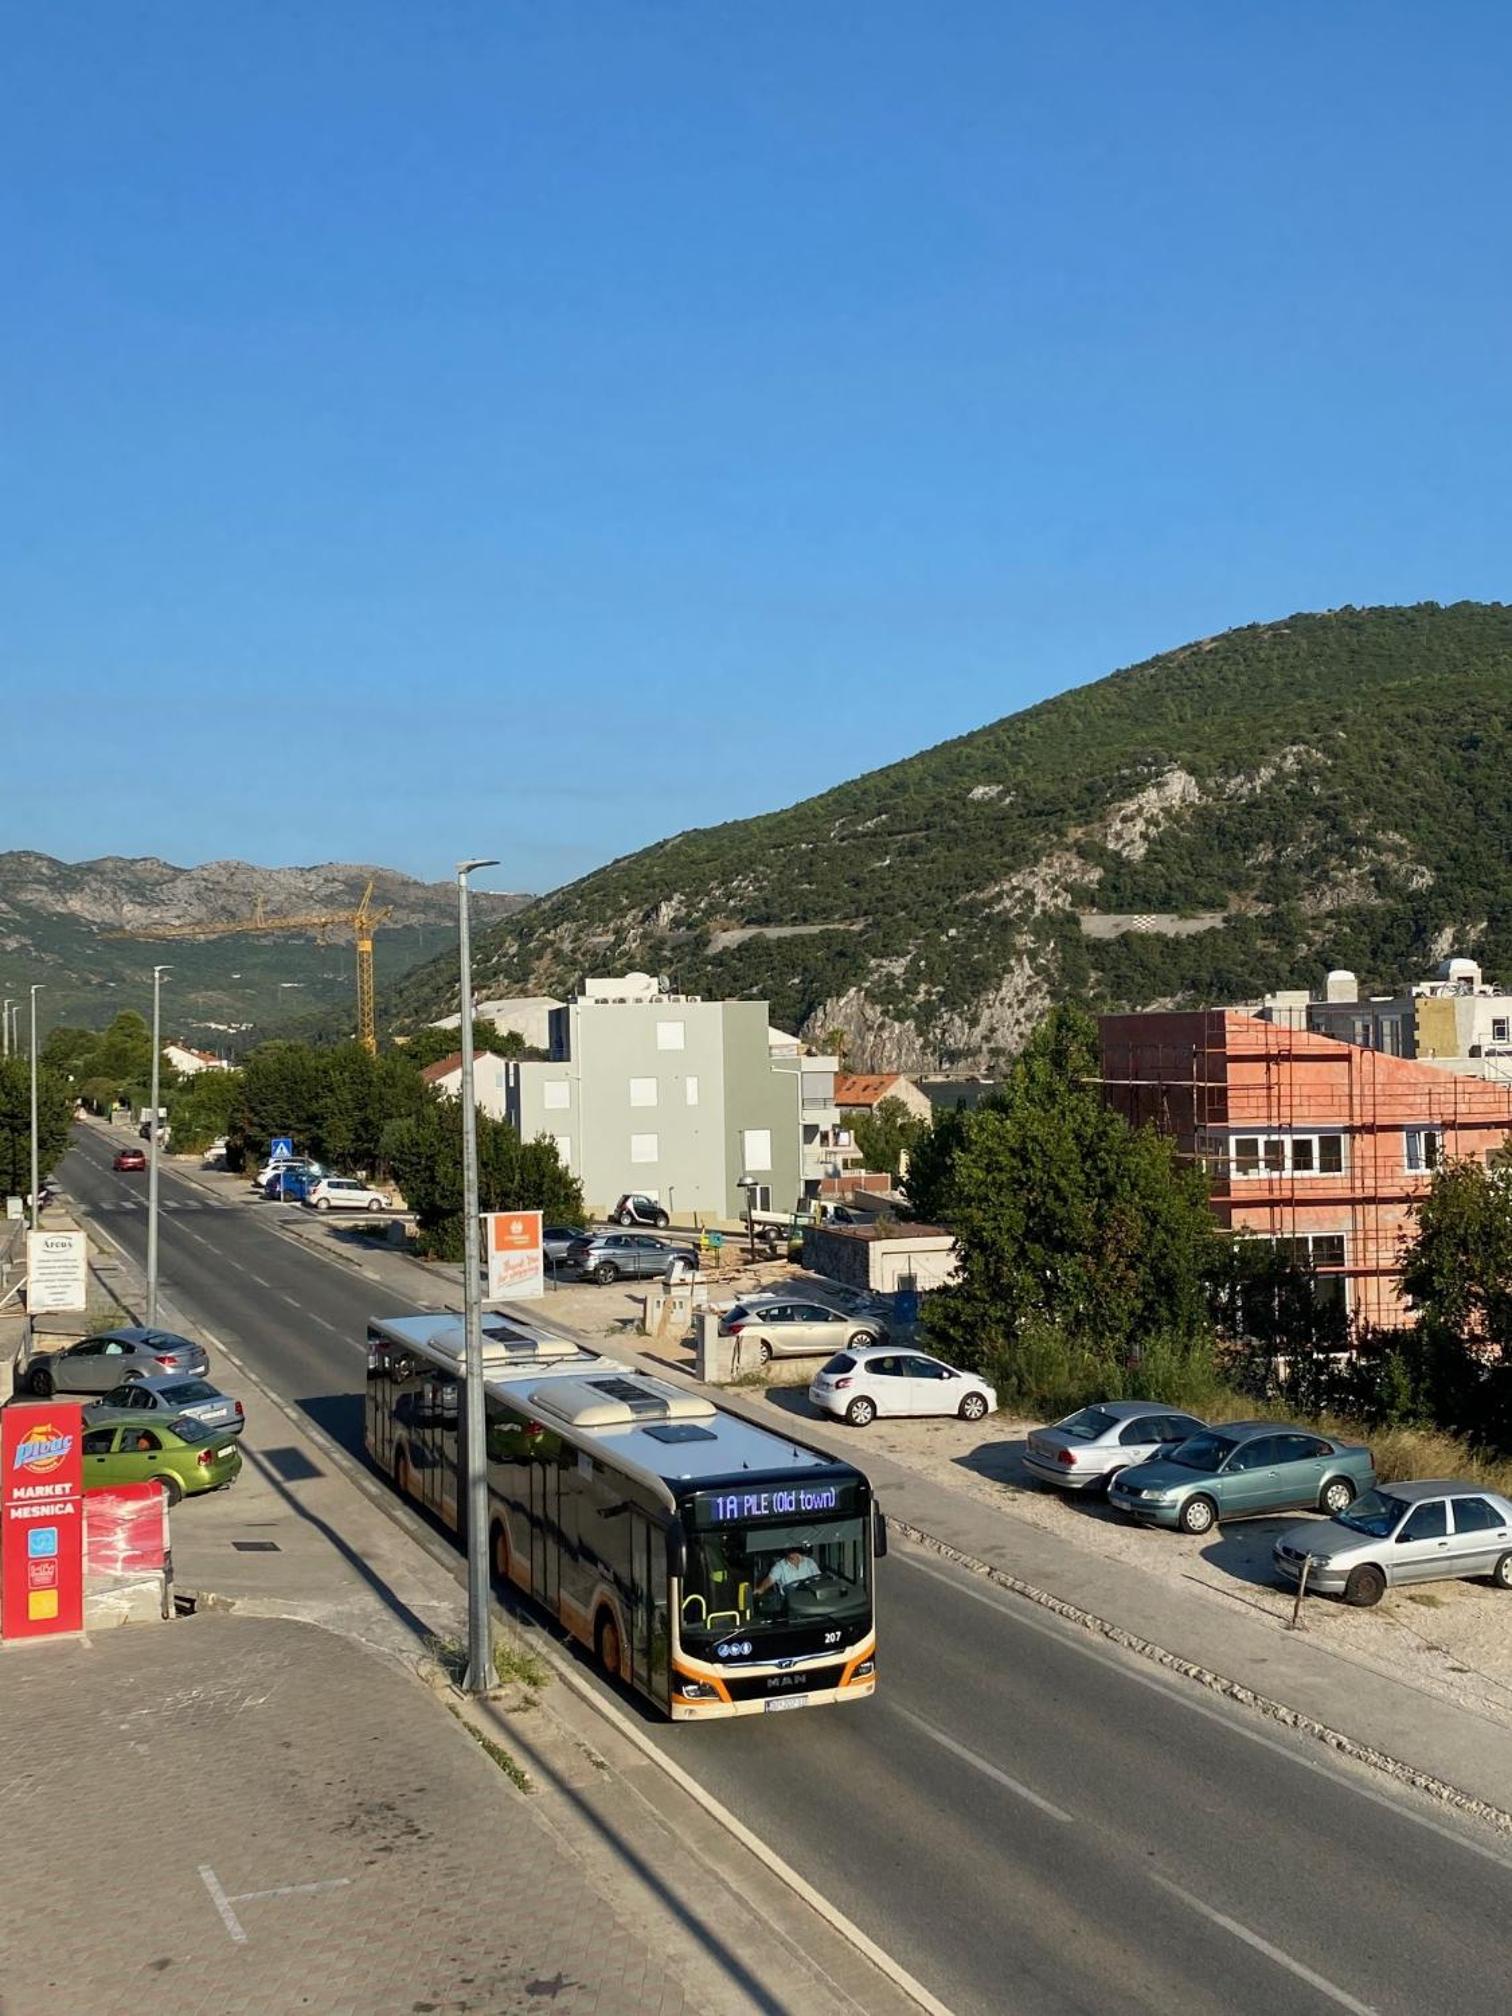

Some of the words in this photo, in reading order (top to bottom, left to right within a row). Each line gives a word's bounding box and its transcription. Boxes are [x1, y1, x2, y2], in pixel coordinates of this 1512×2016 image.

[12, 1482, 73, 1499] MARKET
[10, 1502, 75, 1519] MESNICA
[717, 1495, 738, 1520] 1A
[744, 1494, 769, 1517] PILE
[773, 1490, 796, 1513] (Old
[799, 1487, 836, 1510] town)
[824, 1631, 842, 1644] 207
[766, 1674, 807, 1688] MAN
